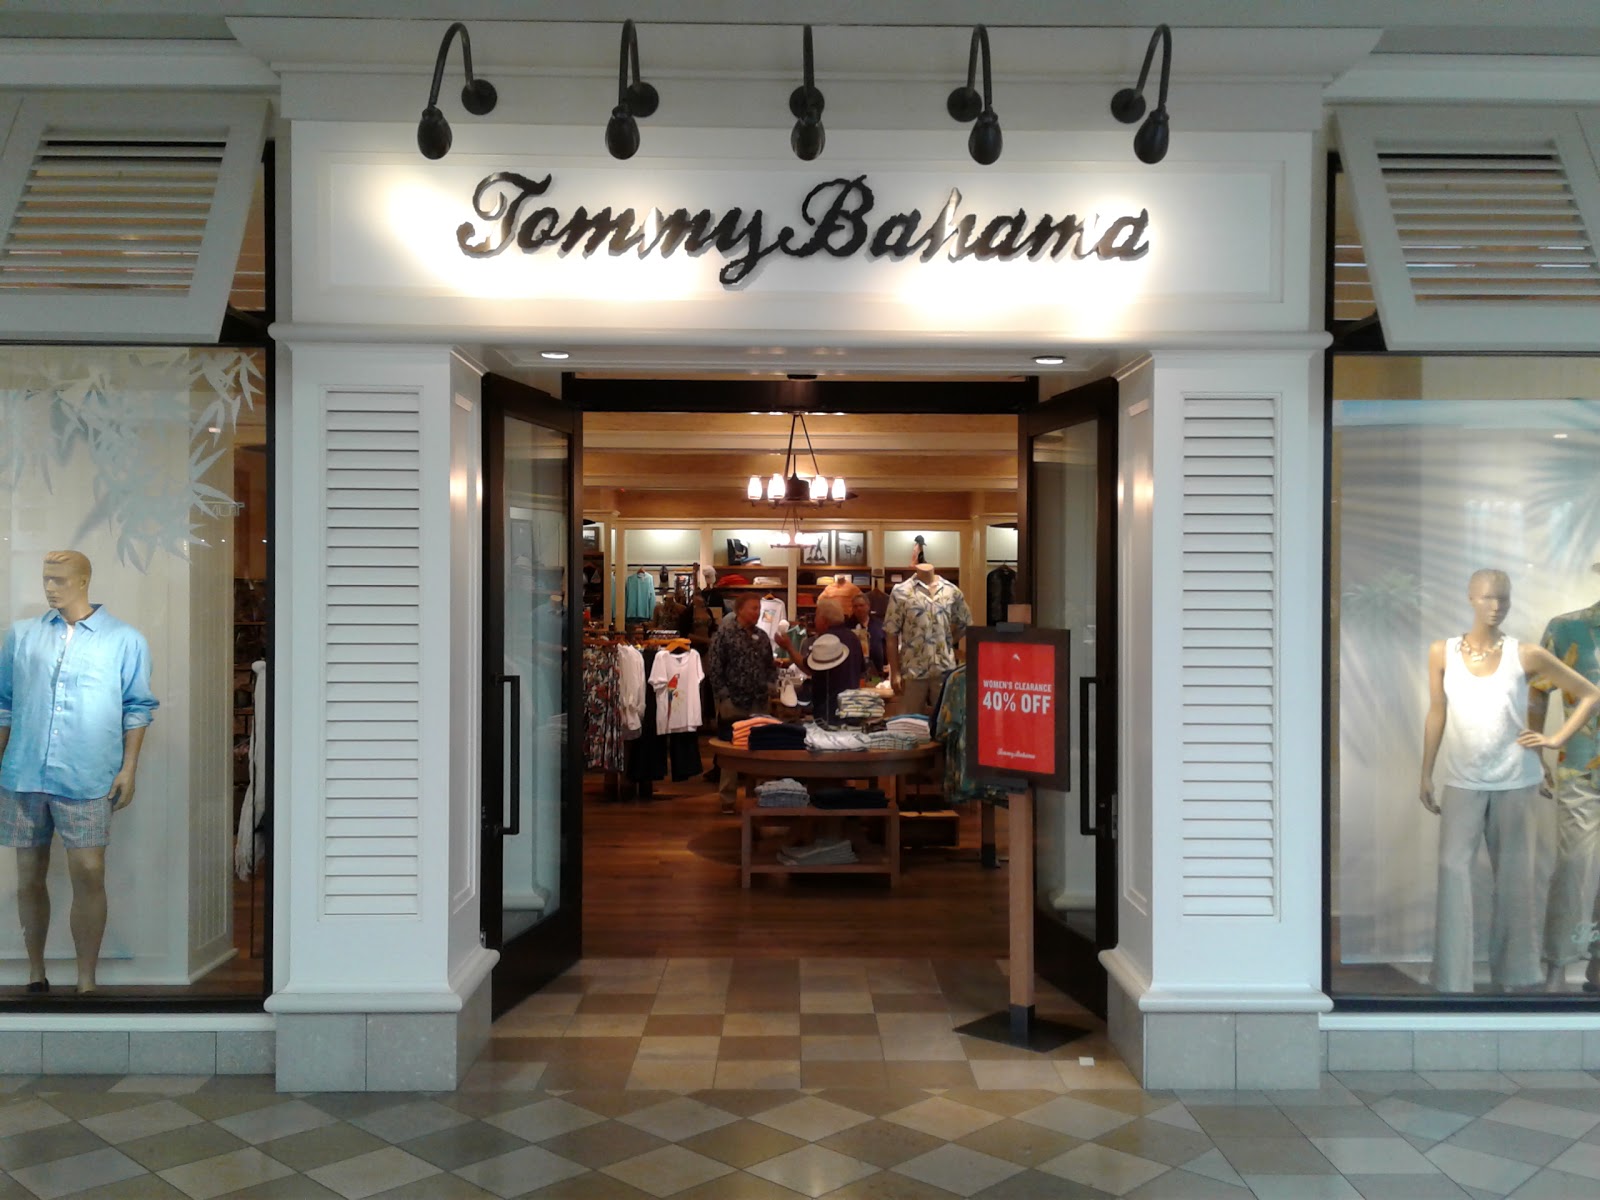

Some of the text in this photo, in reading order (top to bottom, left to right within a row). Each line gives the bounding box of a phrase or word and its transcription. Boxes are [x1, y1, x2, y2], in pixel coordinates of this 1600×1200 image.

[457, 171, 1150, 288] Tommy Bahama
[983, 680, 1053, 693] WOMEN'S CLEARANCE
[983, 692, 1052, 715] 40% OFF
